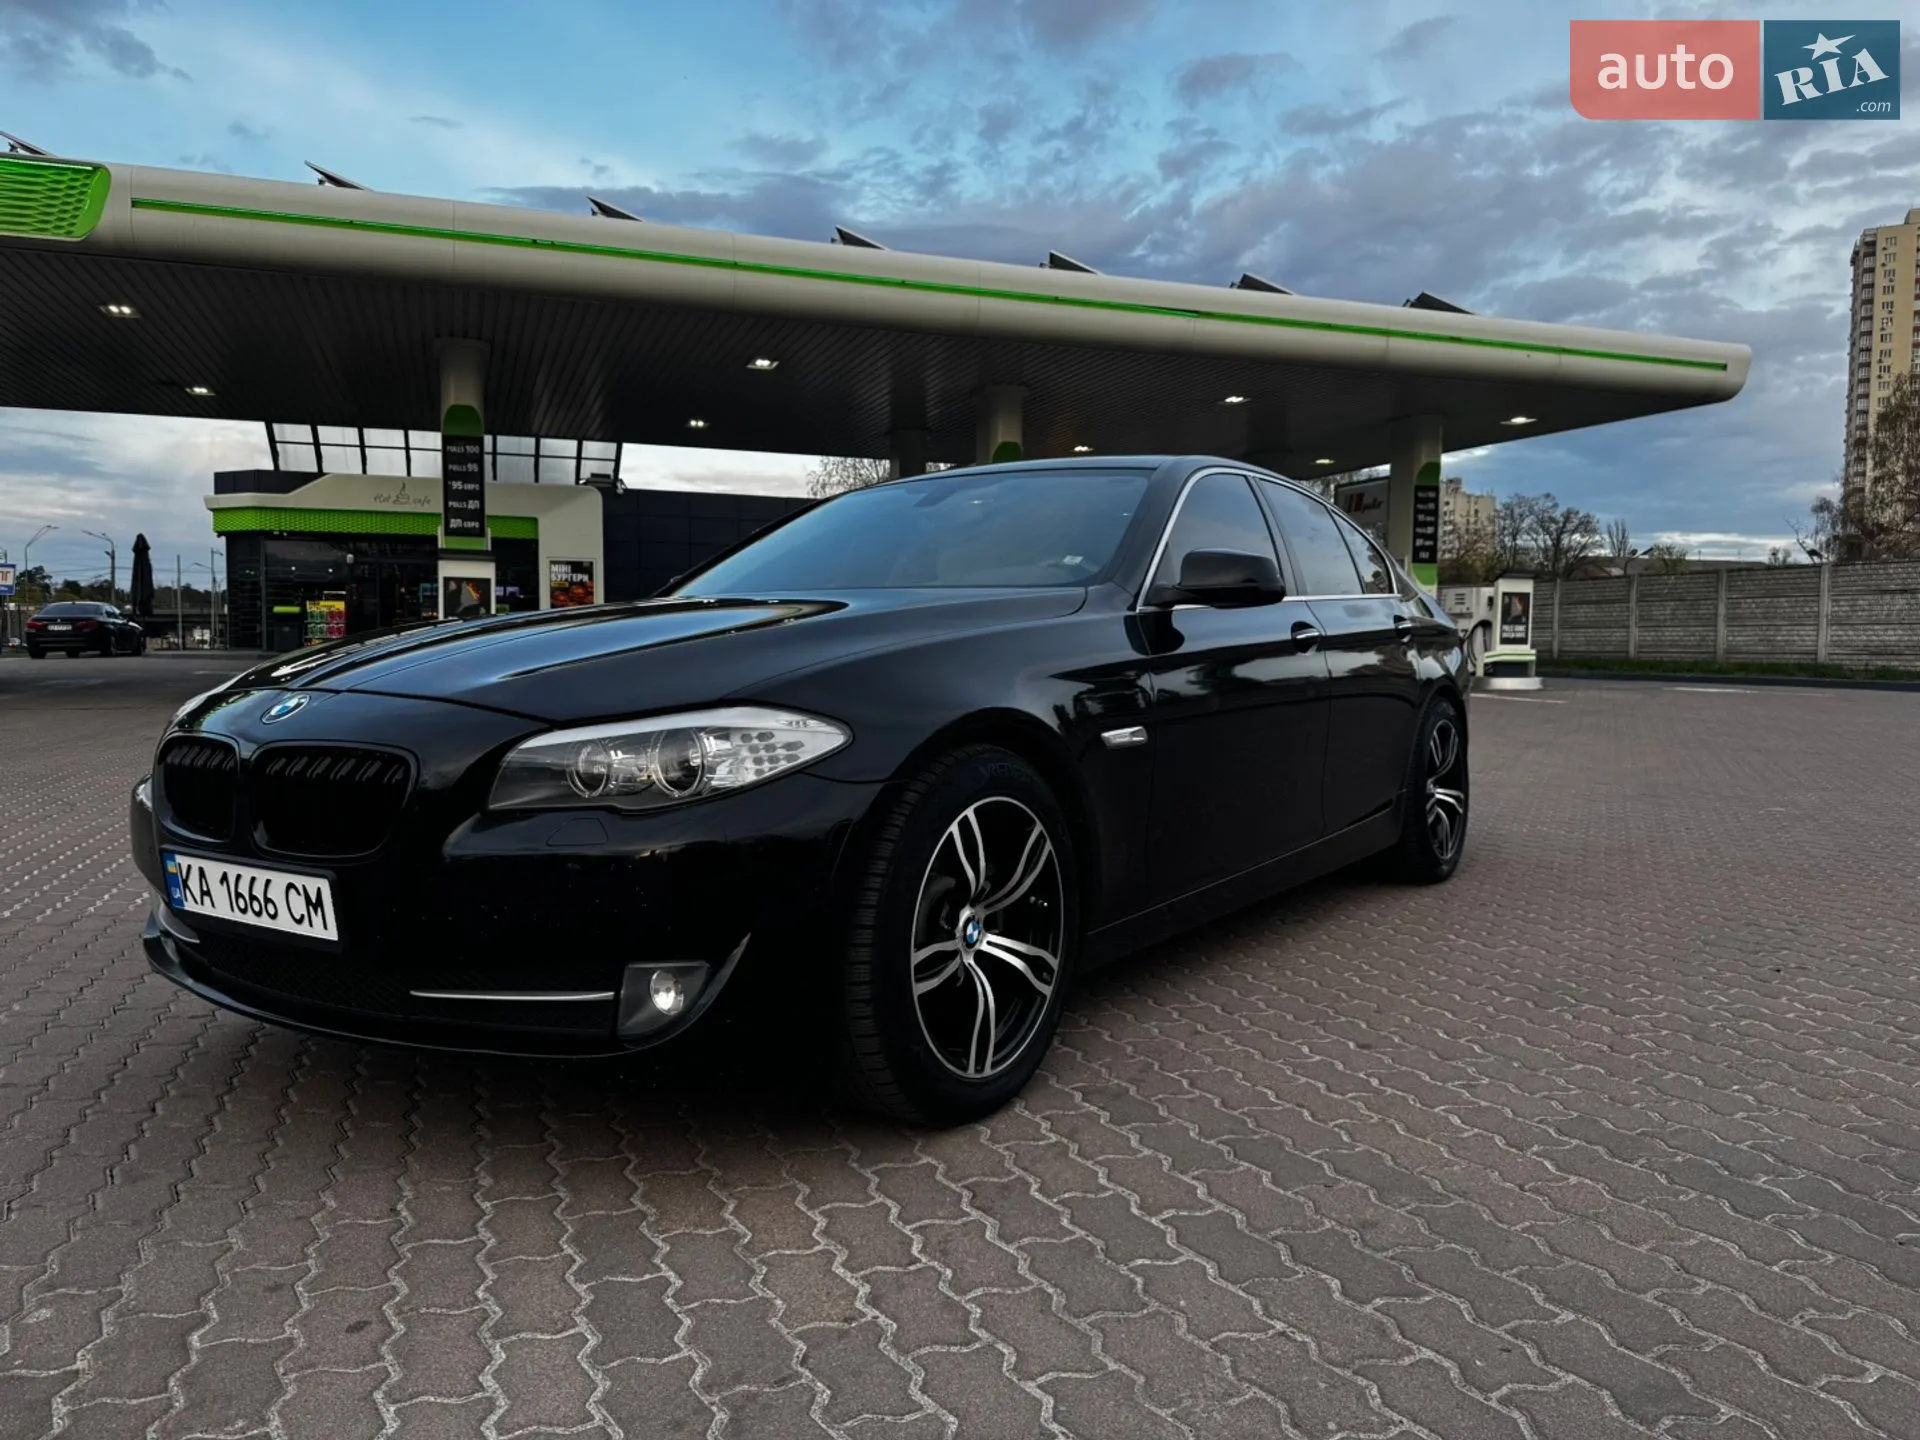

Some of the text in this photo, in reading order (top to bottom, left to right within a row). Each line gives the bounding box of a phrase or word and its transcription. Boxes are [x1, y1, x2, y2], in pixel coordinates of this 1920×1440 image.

[178, 862, 329, 931] KA 1666 CM
